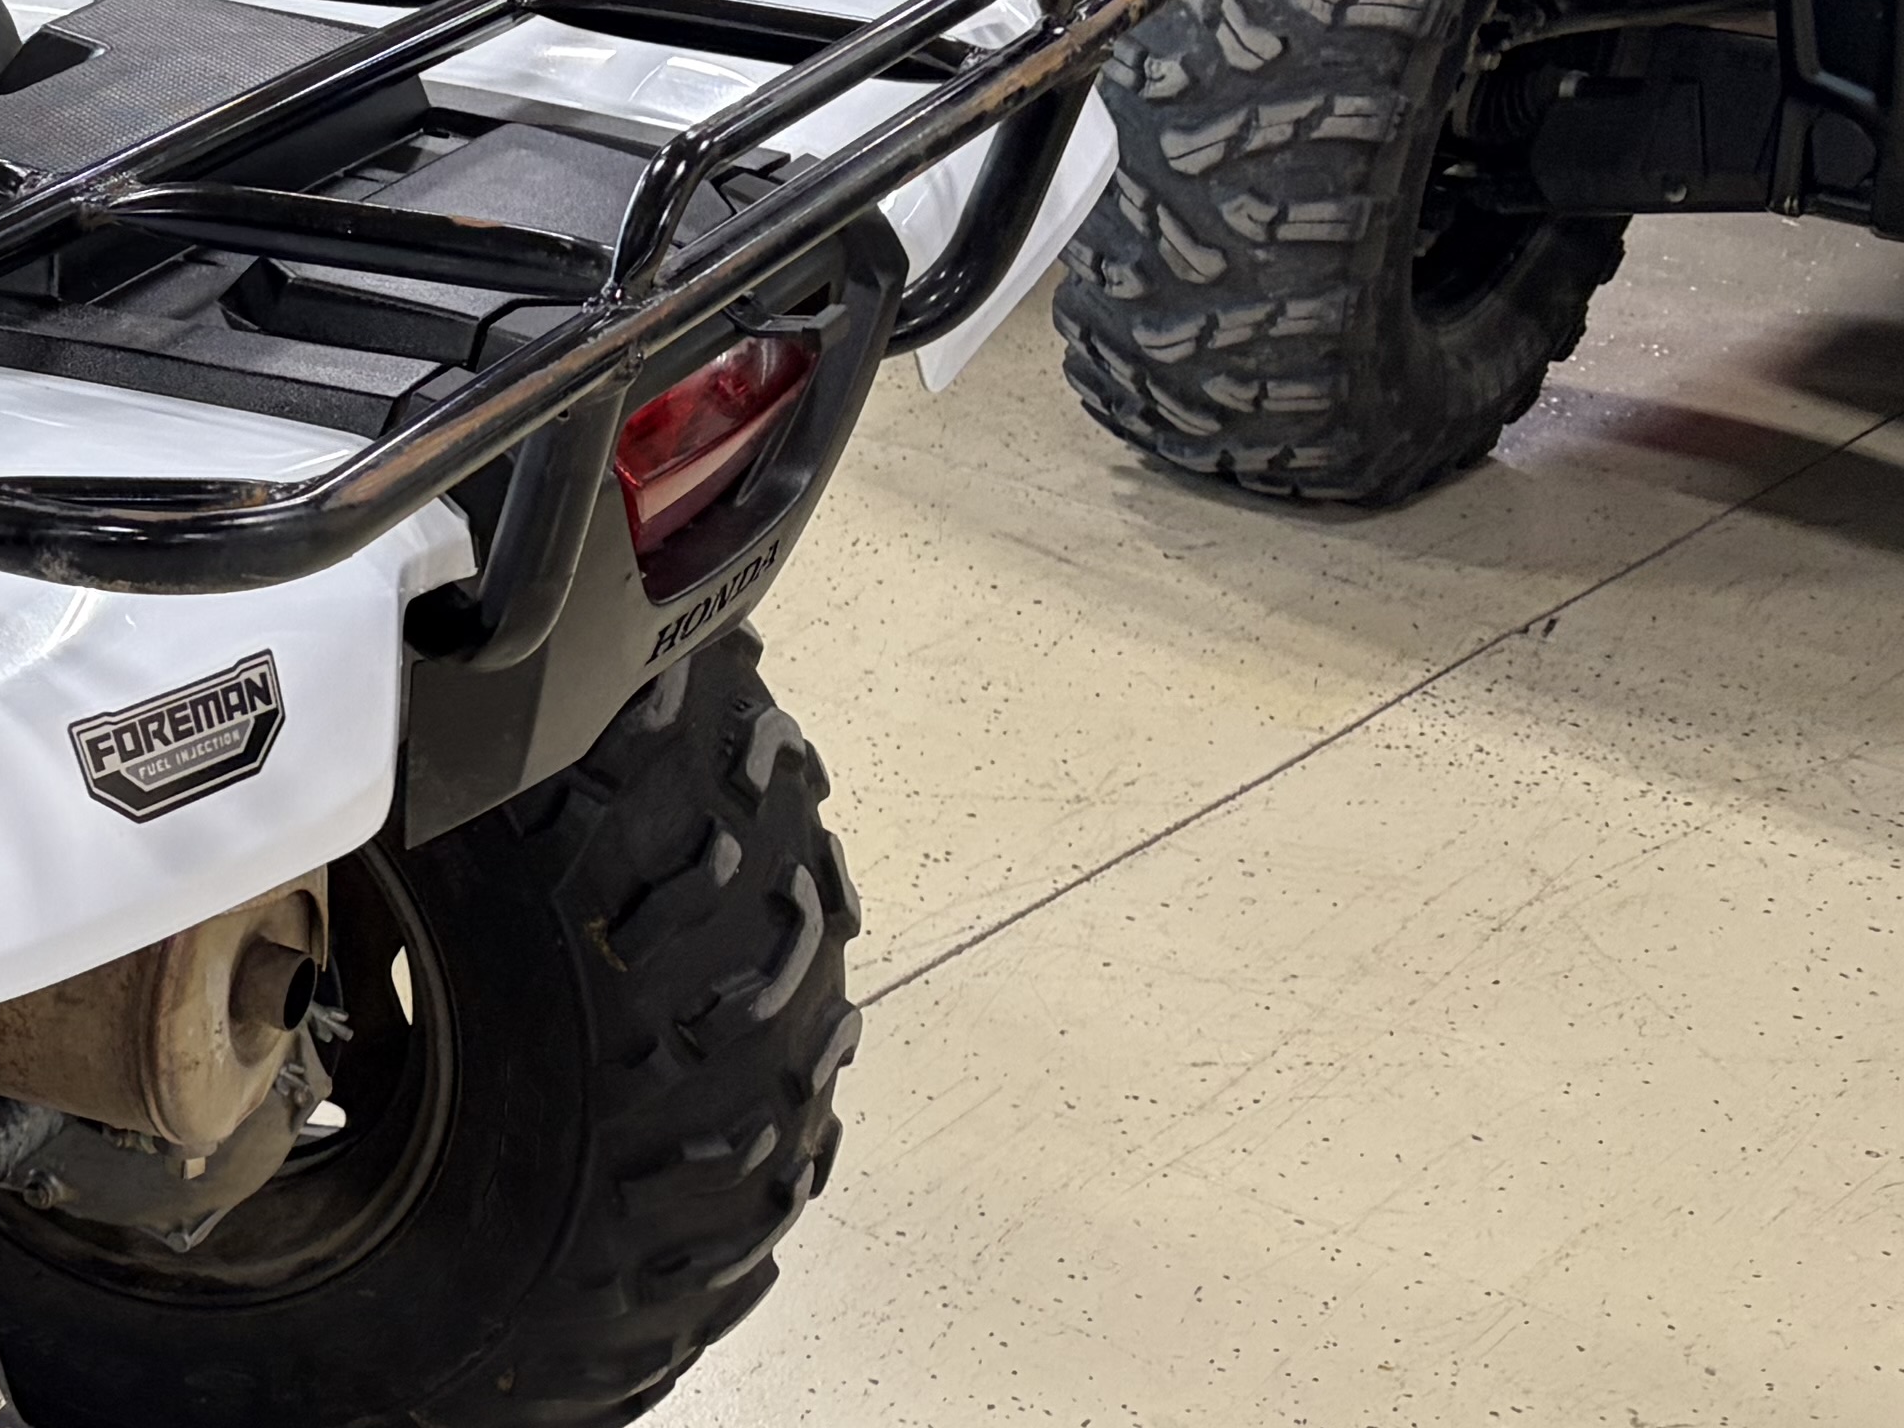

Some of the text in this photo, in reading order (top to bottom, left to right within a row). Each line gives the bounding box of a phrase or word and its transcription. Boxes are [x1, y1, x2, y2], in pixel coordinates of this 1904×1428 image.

[645, 539, 781, 667] HONDA
[85, 671, 274, 774] FOREMAN
[137, 727, 242, 781] FUEL INJECTION
